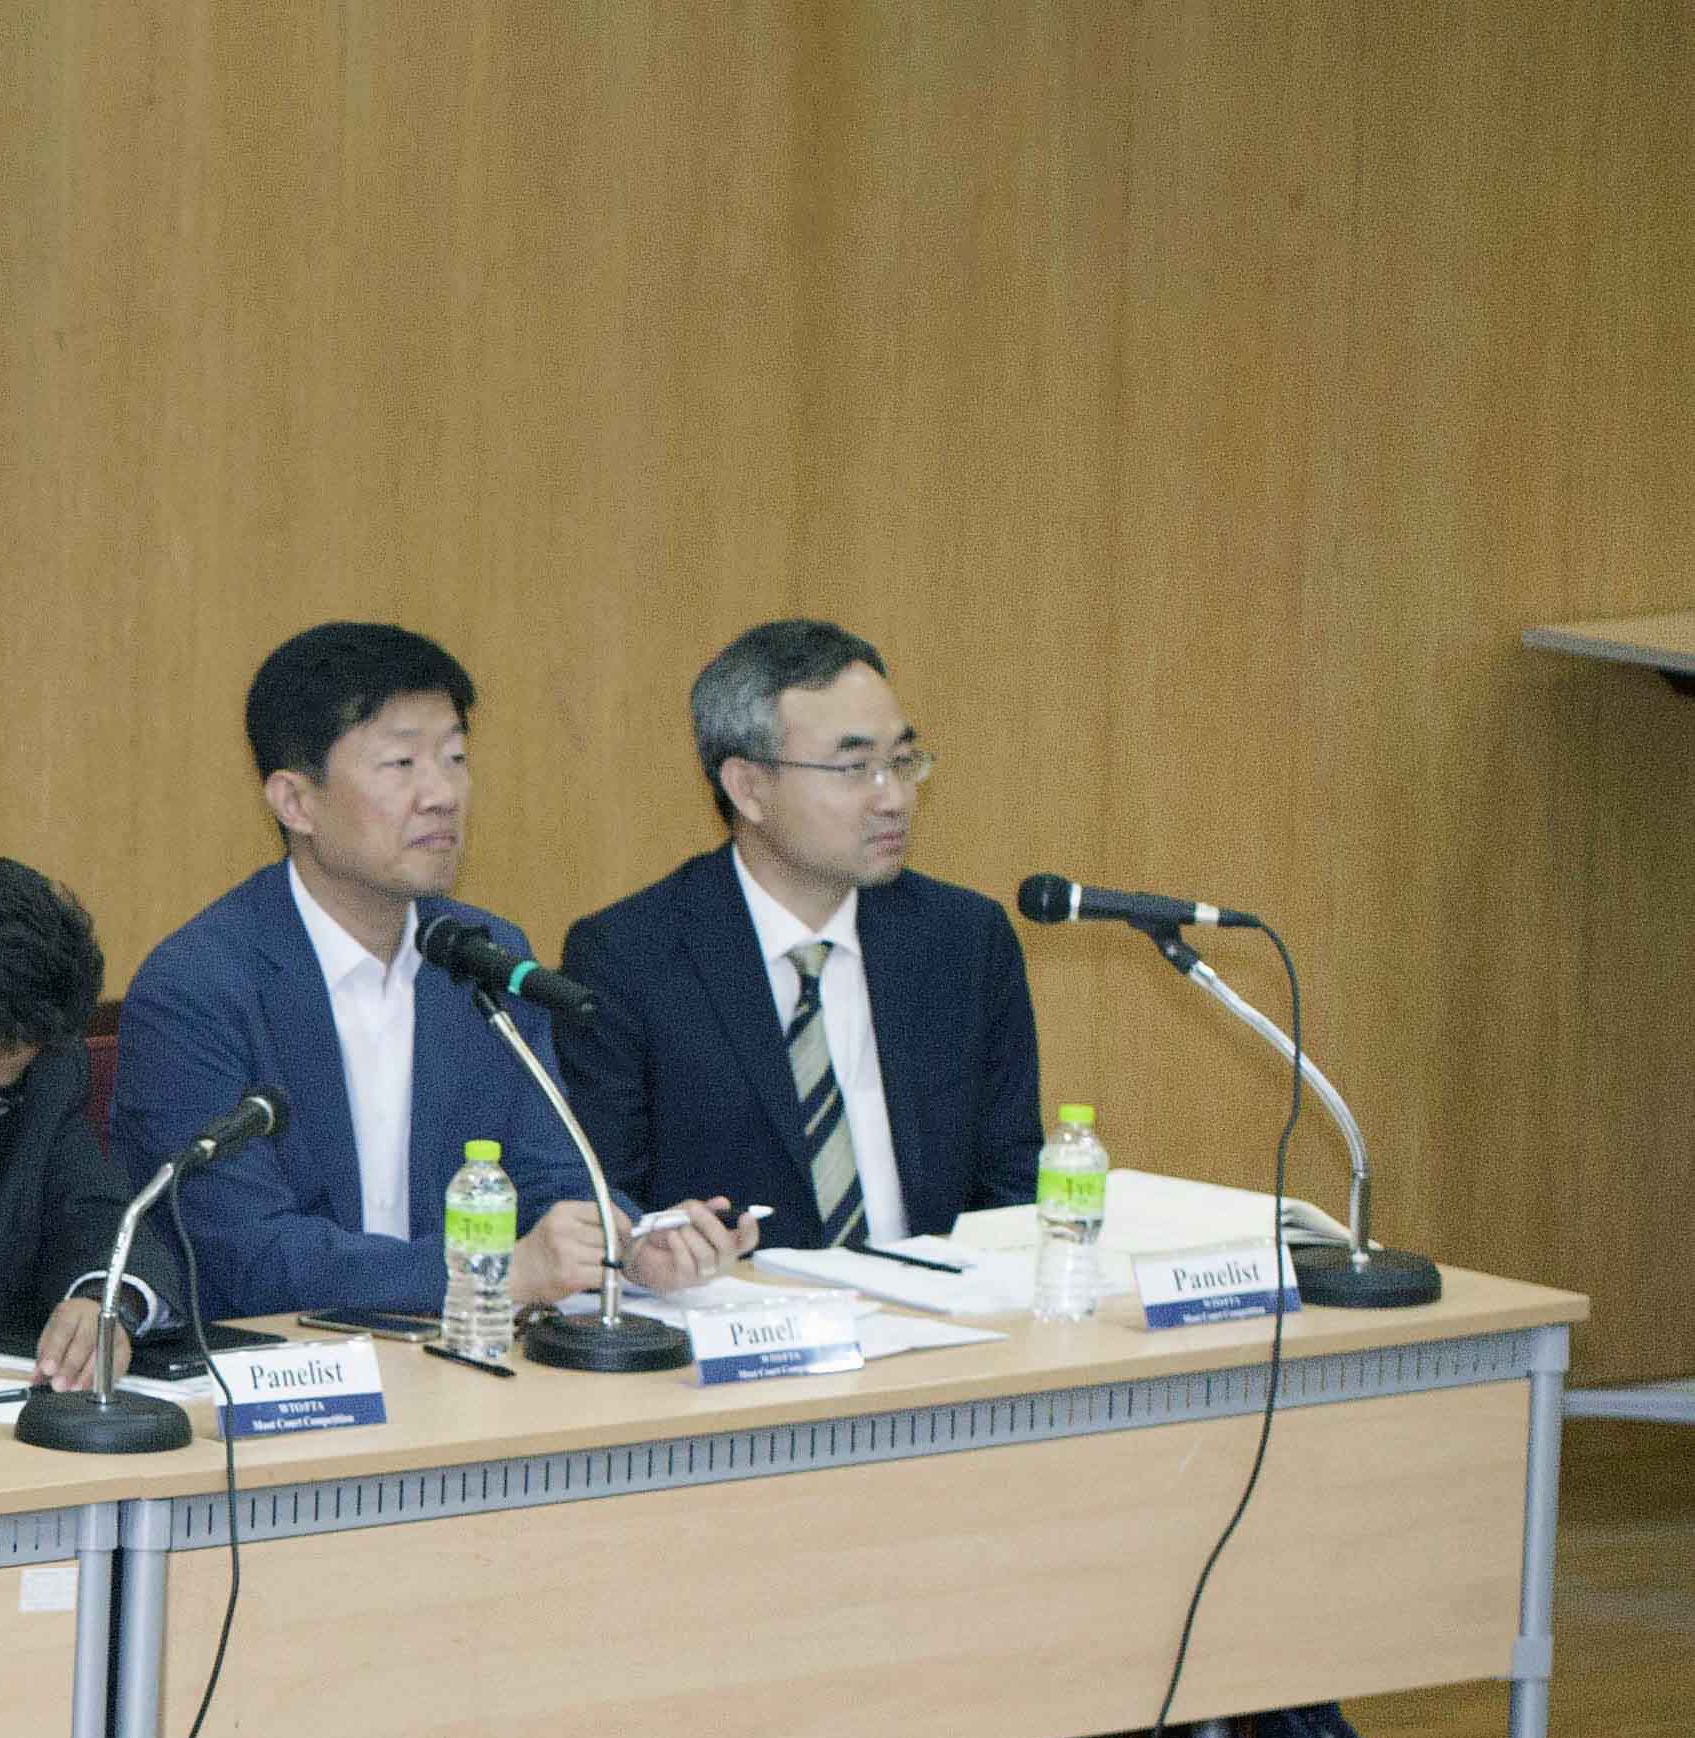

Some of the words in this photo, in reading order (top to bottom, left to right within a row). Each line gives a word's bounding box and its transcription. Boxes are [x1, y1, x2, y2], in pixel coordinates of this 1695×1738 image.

[1172, 1261, 1260, 1292] Panelist
[729, 1316, 801, 1347] Panel
[250, 1360, 344, 1391] Panelist
